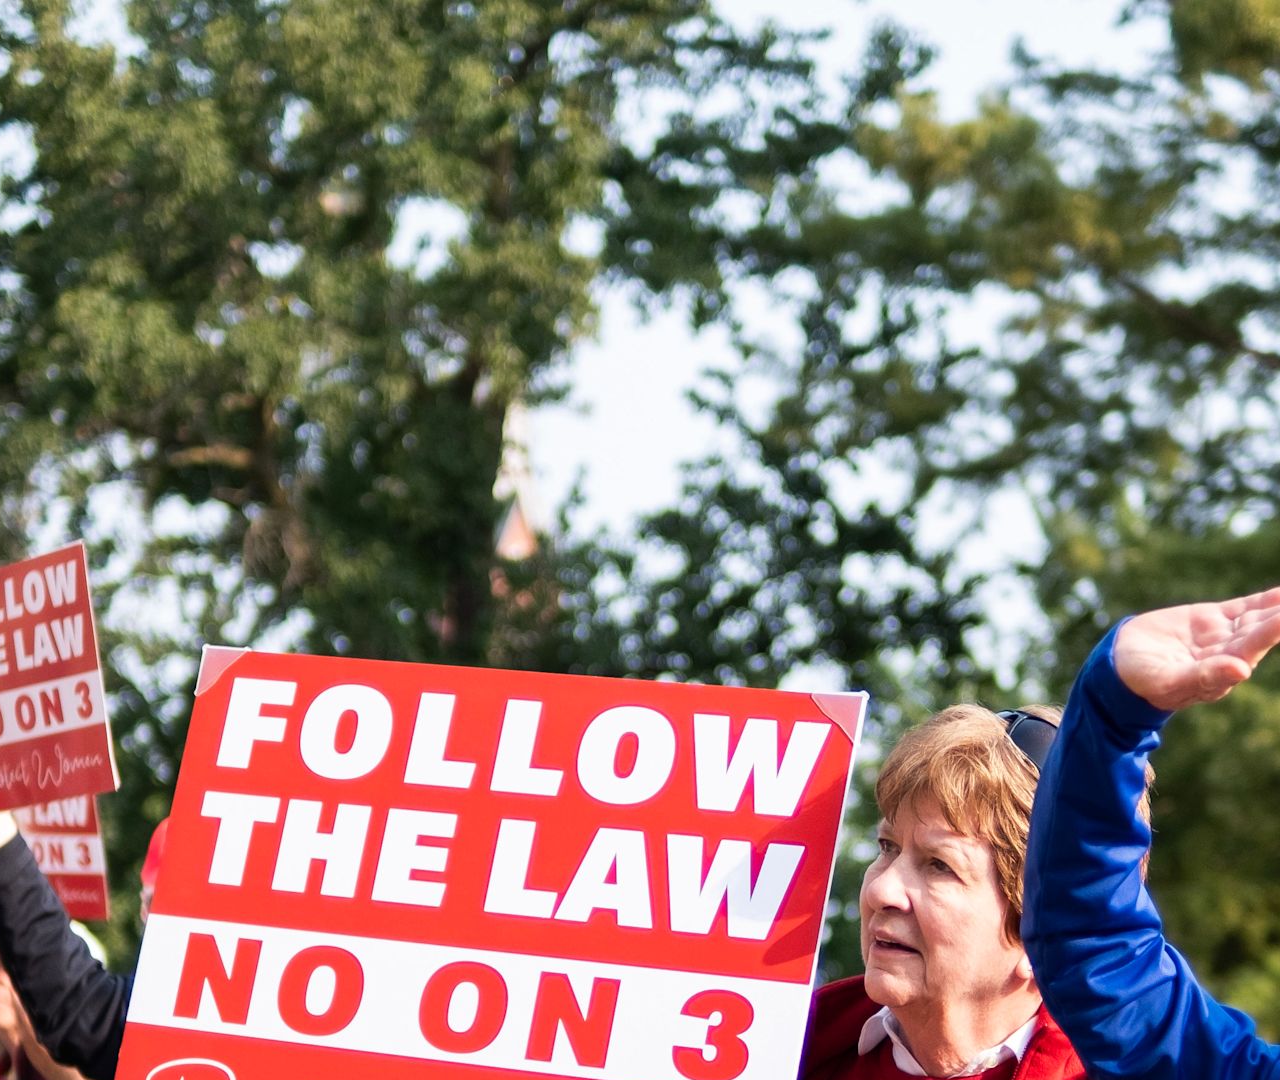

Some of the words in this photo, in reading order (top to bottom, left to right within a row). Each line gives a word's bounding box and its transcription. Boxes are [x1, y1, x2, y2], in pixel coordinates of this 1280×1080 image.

[13, 613, 84, 670] LAW
[15, 687, 64, 733] ON
[74, 681, 94, 720] 3
[32, 743, 103, 790] Women
[216, 676, 832, 818] FOLLOW
[76, 842, 92, 867] 3
[200, 790, 458, 908] THE
[484, 817, 806, 940] LAW
[173, 932, 364, 1036] NO
[418, 960, 620, 1069] ON
